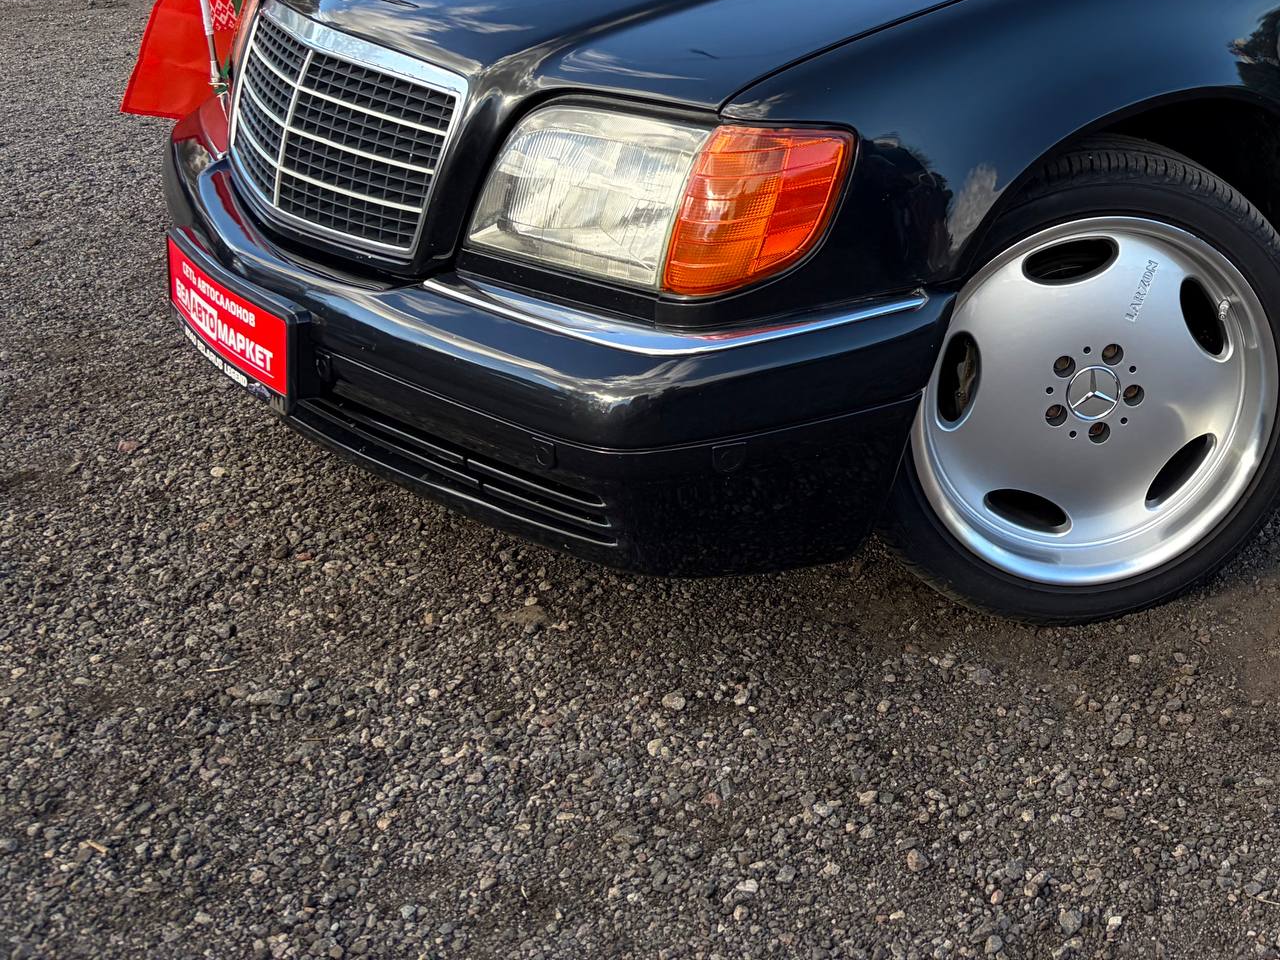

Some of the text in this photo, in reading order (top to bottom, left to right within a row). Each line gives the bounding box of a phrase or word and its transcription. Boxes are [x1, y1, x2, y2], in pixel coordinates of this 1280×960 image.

[176, 278, 274, 372] БЕЛ АВТО МАРКЕТ
[182, 261, 256, 328] СЕТЬ АВТОСАЛОНОВ
